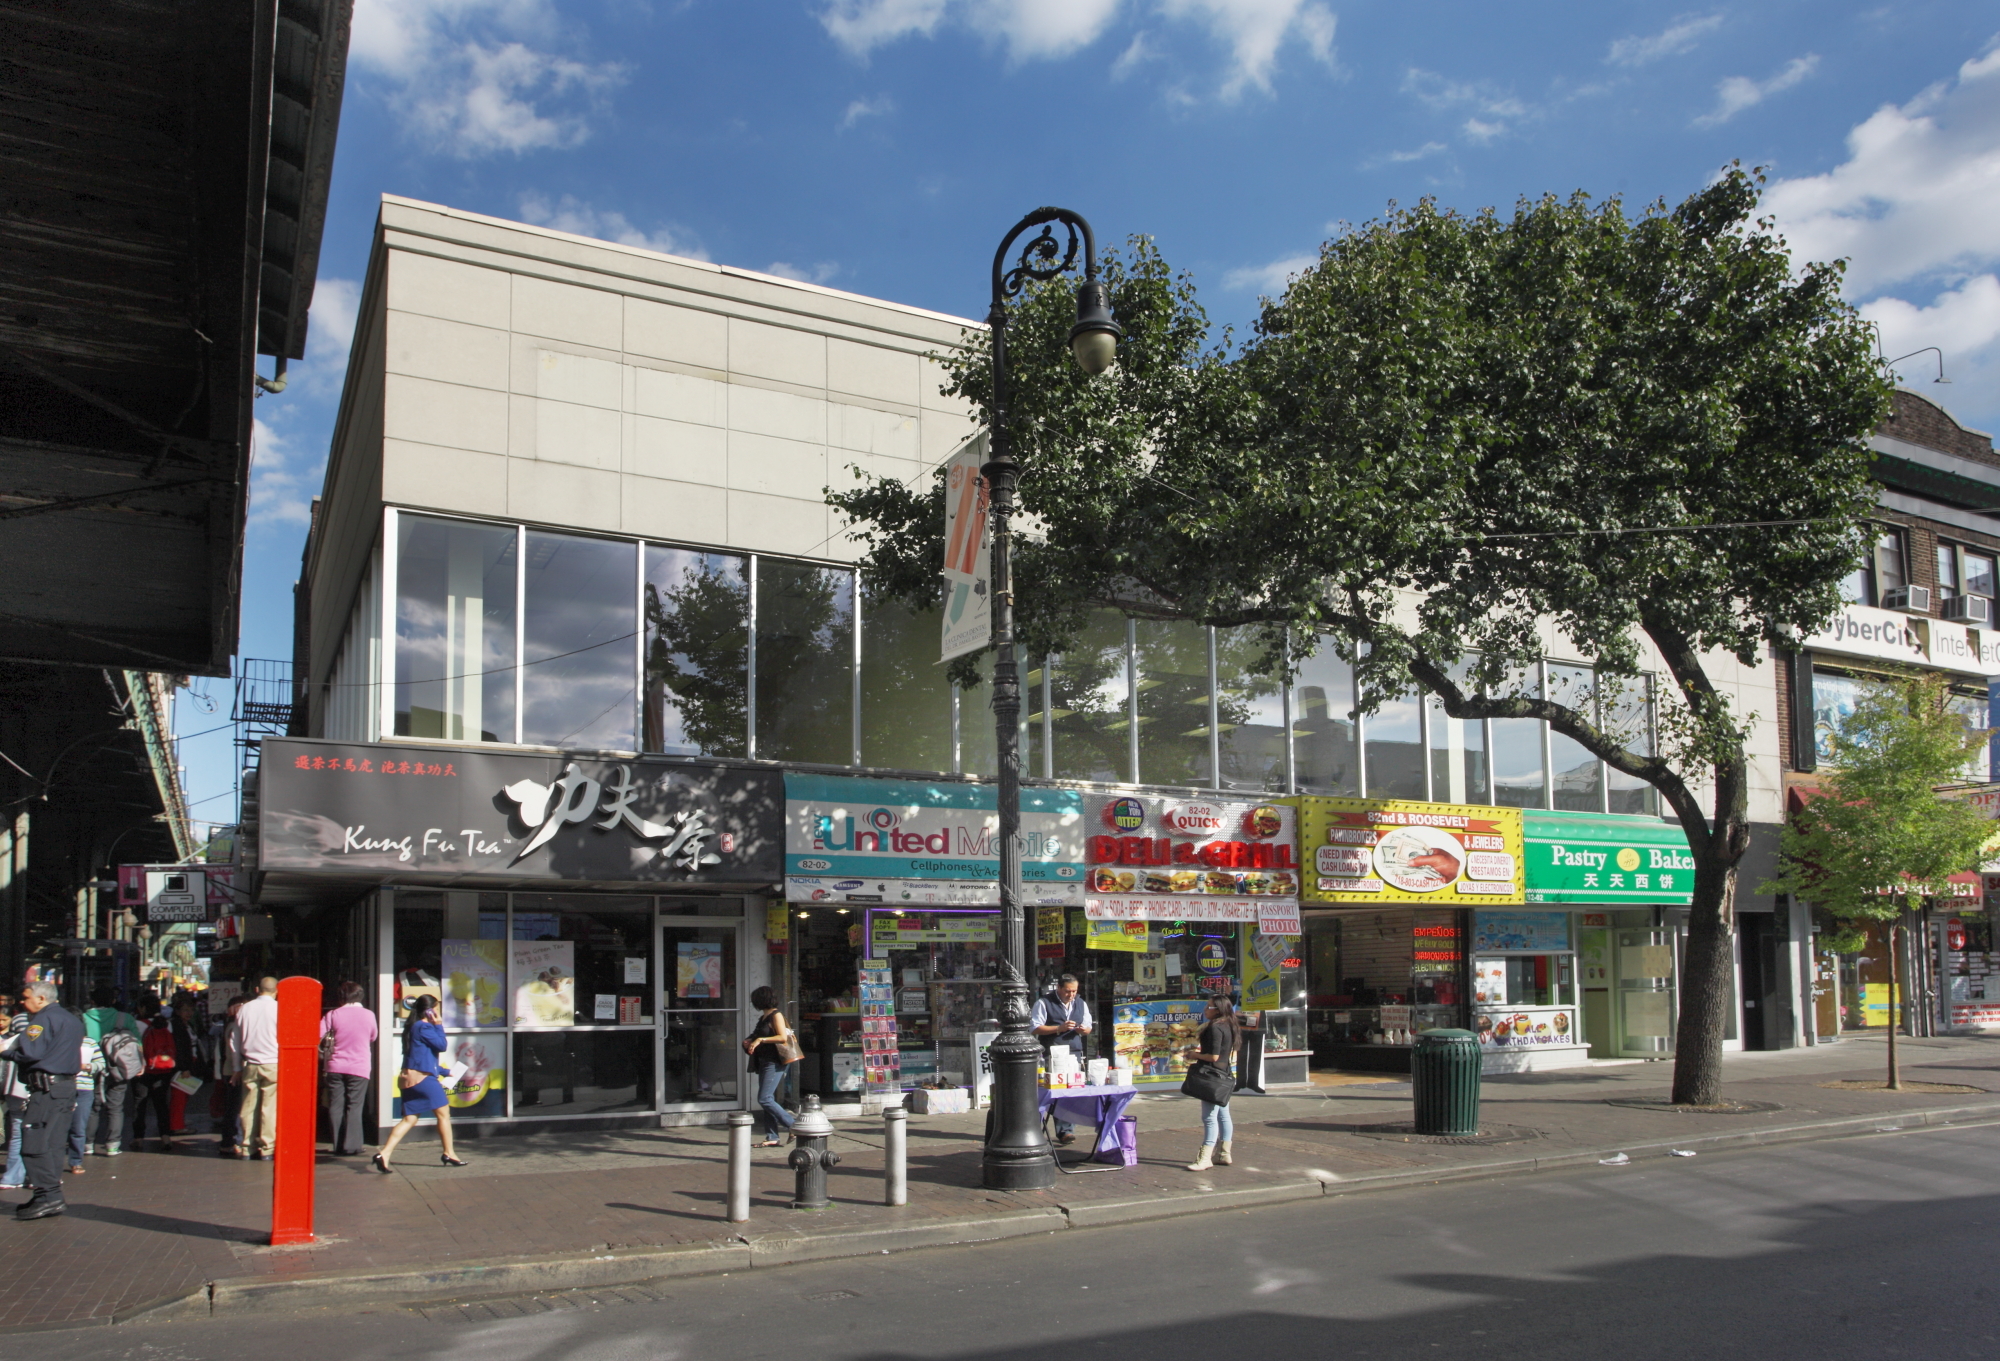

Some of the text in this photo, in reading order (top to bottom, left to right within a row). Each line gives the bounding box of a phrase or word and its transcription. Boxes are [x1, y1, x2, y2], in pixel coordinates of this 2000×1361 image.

[1127, 800, 1138, 808] NEW
[1128, 807, 1141, 816] YORK
[1189, 806, 1211, 815] 82-02
[1115, 816, 1142, 828] LOTTERY
[1177, 816, 1221, 829] QUICK
[1367, 812, 1471, 827] 82nd & ROOSEVELT
[813, 813, 824, 850] new
[344, 825, 502, 861] Kung Fu Tea
[1330, 828, 1504, 850] PAWNBROKERS & JEWELERS
[1093, 835, 1299, 869] DELI & GRILL
[1341, 850, 1368, 860] MONEY?
[1551, 845, 1697, 870] Pastry Baker
[802, 859, 827, 870] 82-02
[911, 860, 973, 872] Cellphones
[1321, 861, 1338, 872] CASH
[1339, 862, 1358, 872] LOANS
[1061, 868, 1074, 876] #3
[1470, 866, 1502, 876] PRESTAMOS
[790, 877, 822, 885] NOKIA
[1320, 878, 1342, 888] JEWELRY
[1348, 880, 1382, 890] ELECTRONICS
[1583, 873, 1674, 889] 天天西饼
[151, 905, 203, 914] COMPUTER
[1109, 900, 1125, 917] SODA
[1129, 901, 1145, 917] BEER
[1149, 901, 1167, 917] PHONE
[1167, 901, 1182, 917] CARD
[1187, 902, 1204, 917] LOTTO
[1207, 902, 1218, 918] ATM
[1222, 902, 1249, 918] CIGARETTE
[1936, 899, 1966, 909] Cejas
[1260, 904, 1295, 916] PASSPORT
[150, 913, 205, 921] SOLUTIONS
[1038, 917, 1060, 926] UNLOCK
[1127, 927, 1144, 935] NYC
[1261, 919, 1297, 933] PHOTO
[1414, 926, 1455, 937] EMPEÑOS
[1438, 940, 1455, 949] GOLD
[444, 943, 485, 958] NEW
[514, 943, 565, 958] Plum Green Tea
[689, 983, 708, 991] Free
[1201, 976, 1232, 988] OPEN
[211, 987, 239, 1000] 5.99
[1256, 985, 1275, 995] NYC
[1154, 1014, 1168, 1022] DELI
[1174, 1012, 1202, 1022] GROCERY
[1496, 1012, 1526, 1034] OFF
[1525, 1024, 1541, 1034] ALL
[1479, 1028, 1497, 1044] 0%
[1541, 1035, 1570, 1046] CAKES
[1057, 1073, 1064, 1084] S
[458, 1084, 480, 1094] Slush
